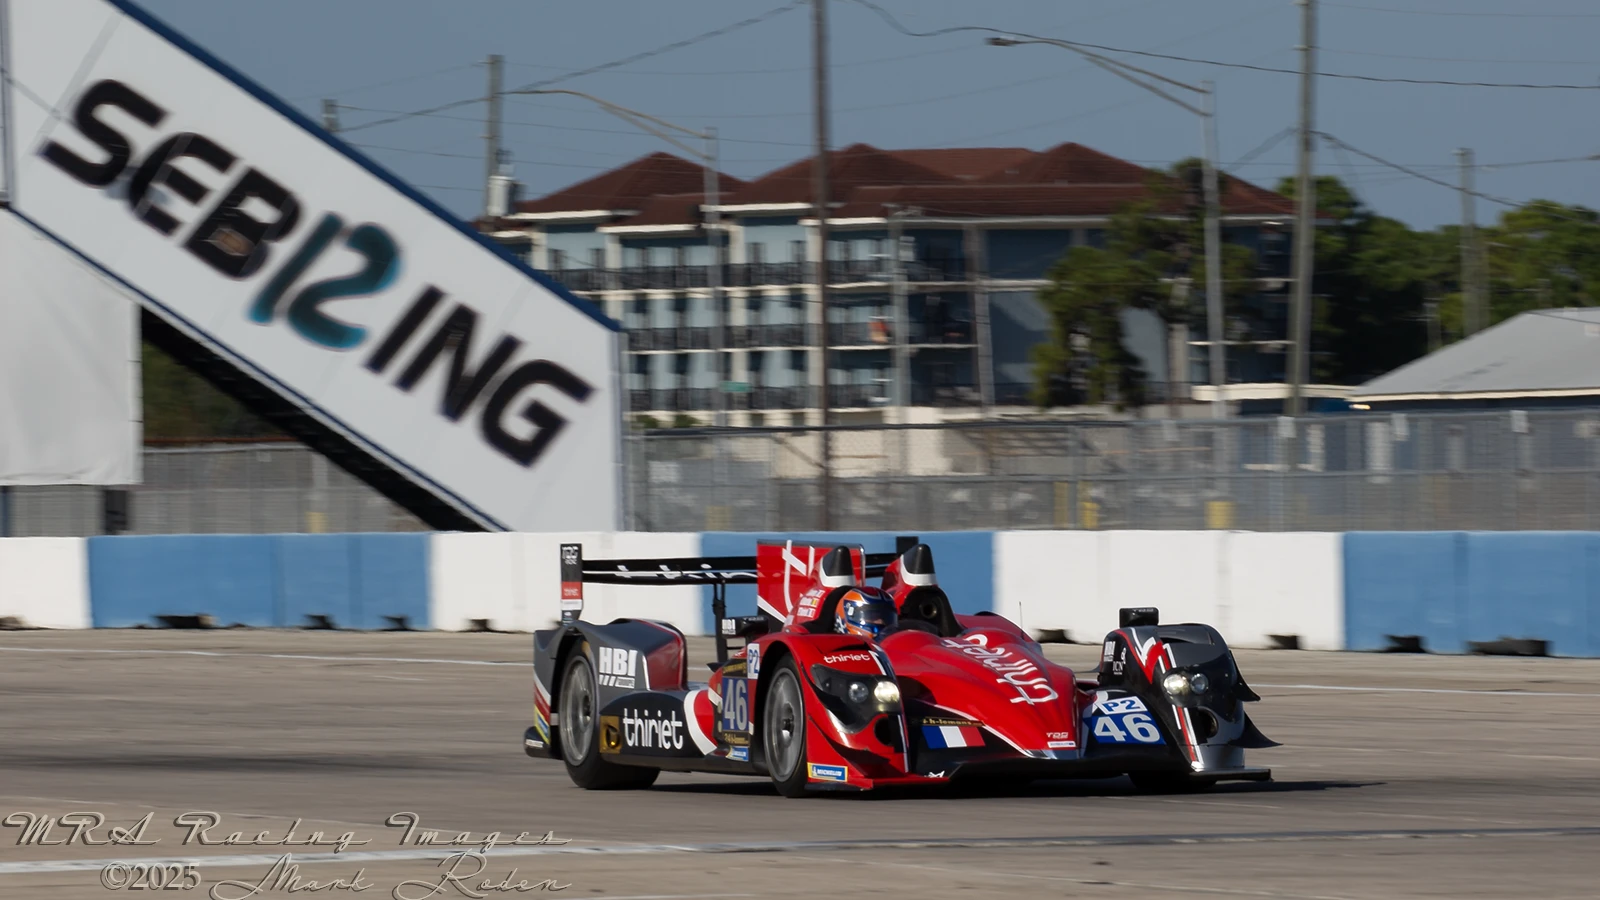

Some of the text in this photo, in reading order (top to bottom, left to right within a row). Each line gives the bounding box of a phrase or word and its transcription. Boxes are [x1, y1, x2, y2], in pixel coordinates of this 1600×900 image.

[36, 78, 597, 469] SEB12ING
[599, 647, 638, 676] HBI
[748, 648, 760, 674] P2
[823, 654, 871, 664] thiriet
[724, 679, 748, 731] 46
[1102, 699, 1141, 712] P2
[622, 708, 684, 750] thiriet
[1093, 713, 1161, 743] 46
